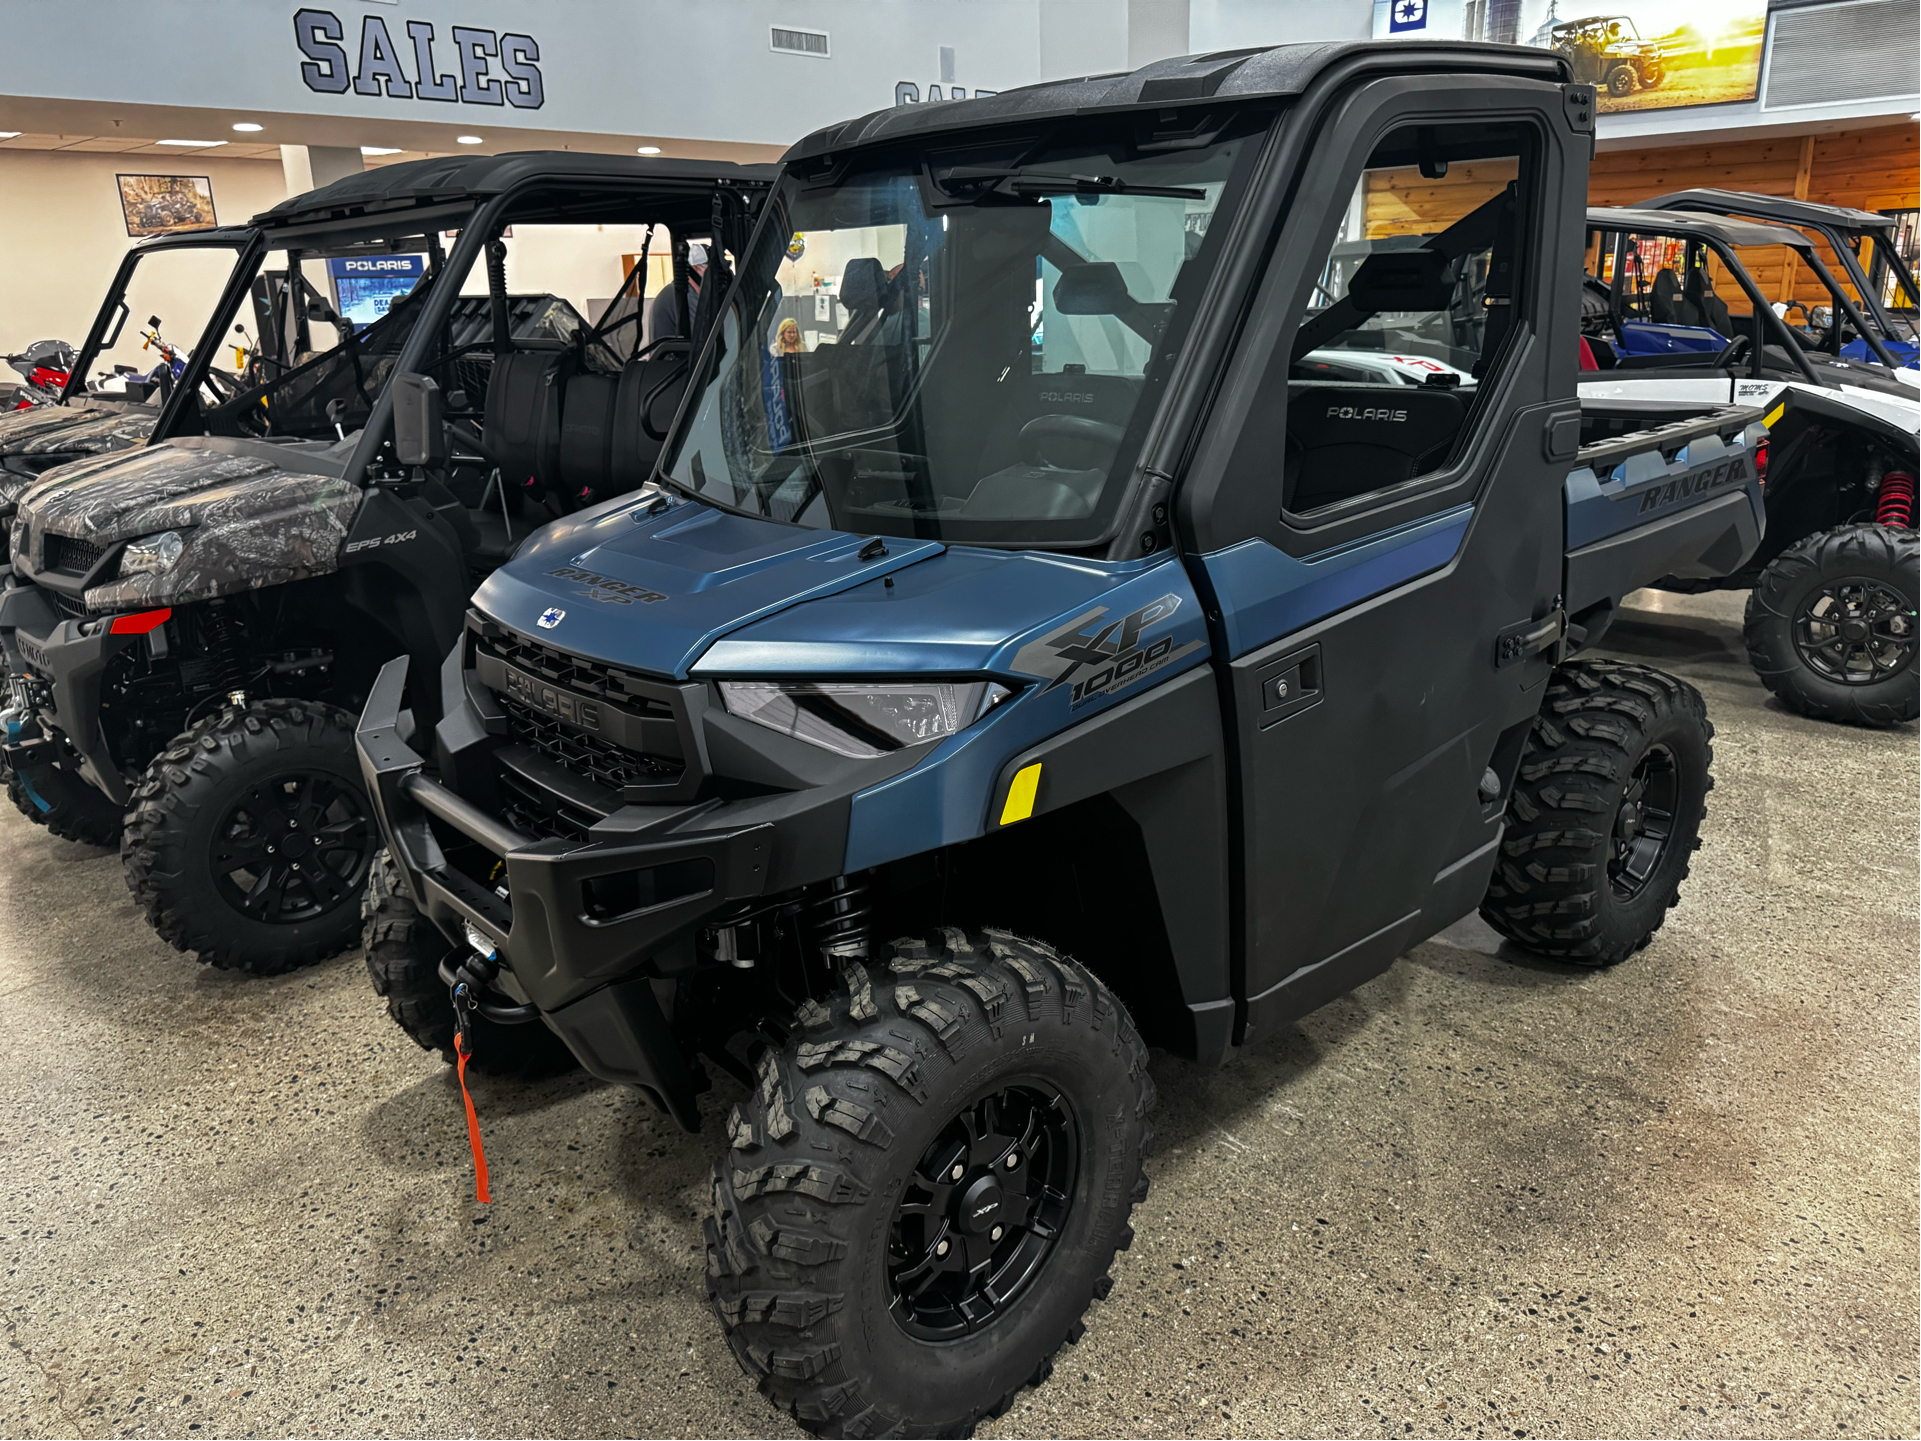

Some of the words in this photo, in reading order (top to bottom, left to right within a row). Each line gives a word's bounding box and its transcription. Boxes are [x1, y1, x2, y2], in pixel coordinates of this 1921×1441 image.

[293, 8, 545, 109] SALES
[345, 261, 412, 271] POLARIS
[1040, 392, 1094, 403] POLARIS
[1326, 407, 1408, 422] POLARIS
[1637, 458, 1746, 515] RANGER
[345, 537, 382, 553] EPS
[384, 529, 417, 544] 4X4
[543, 567, 670, 605] RANGER
[570, 588, 634, 605] XP
[1035, 592, 1183, 699] XP
[1070, 635, 1173, 705] 1000
[1098, 667, 1148, 697] OVERHEAD
[1149, 656, 1170, 670] CAM
[506, 668, 600, 731] POLARIS
[973, 1202, 998, 1218] XP
